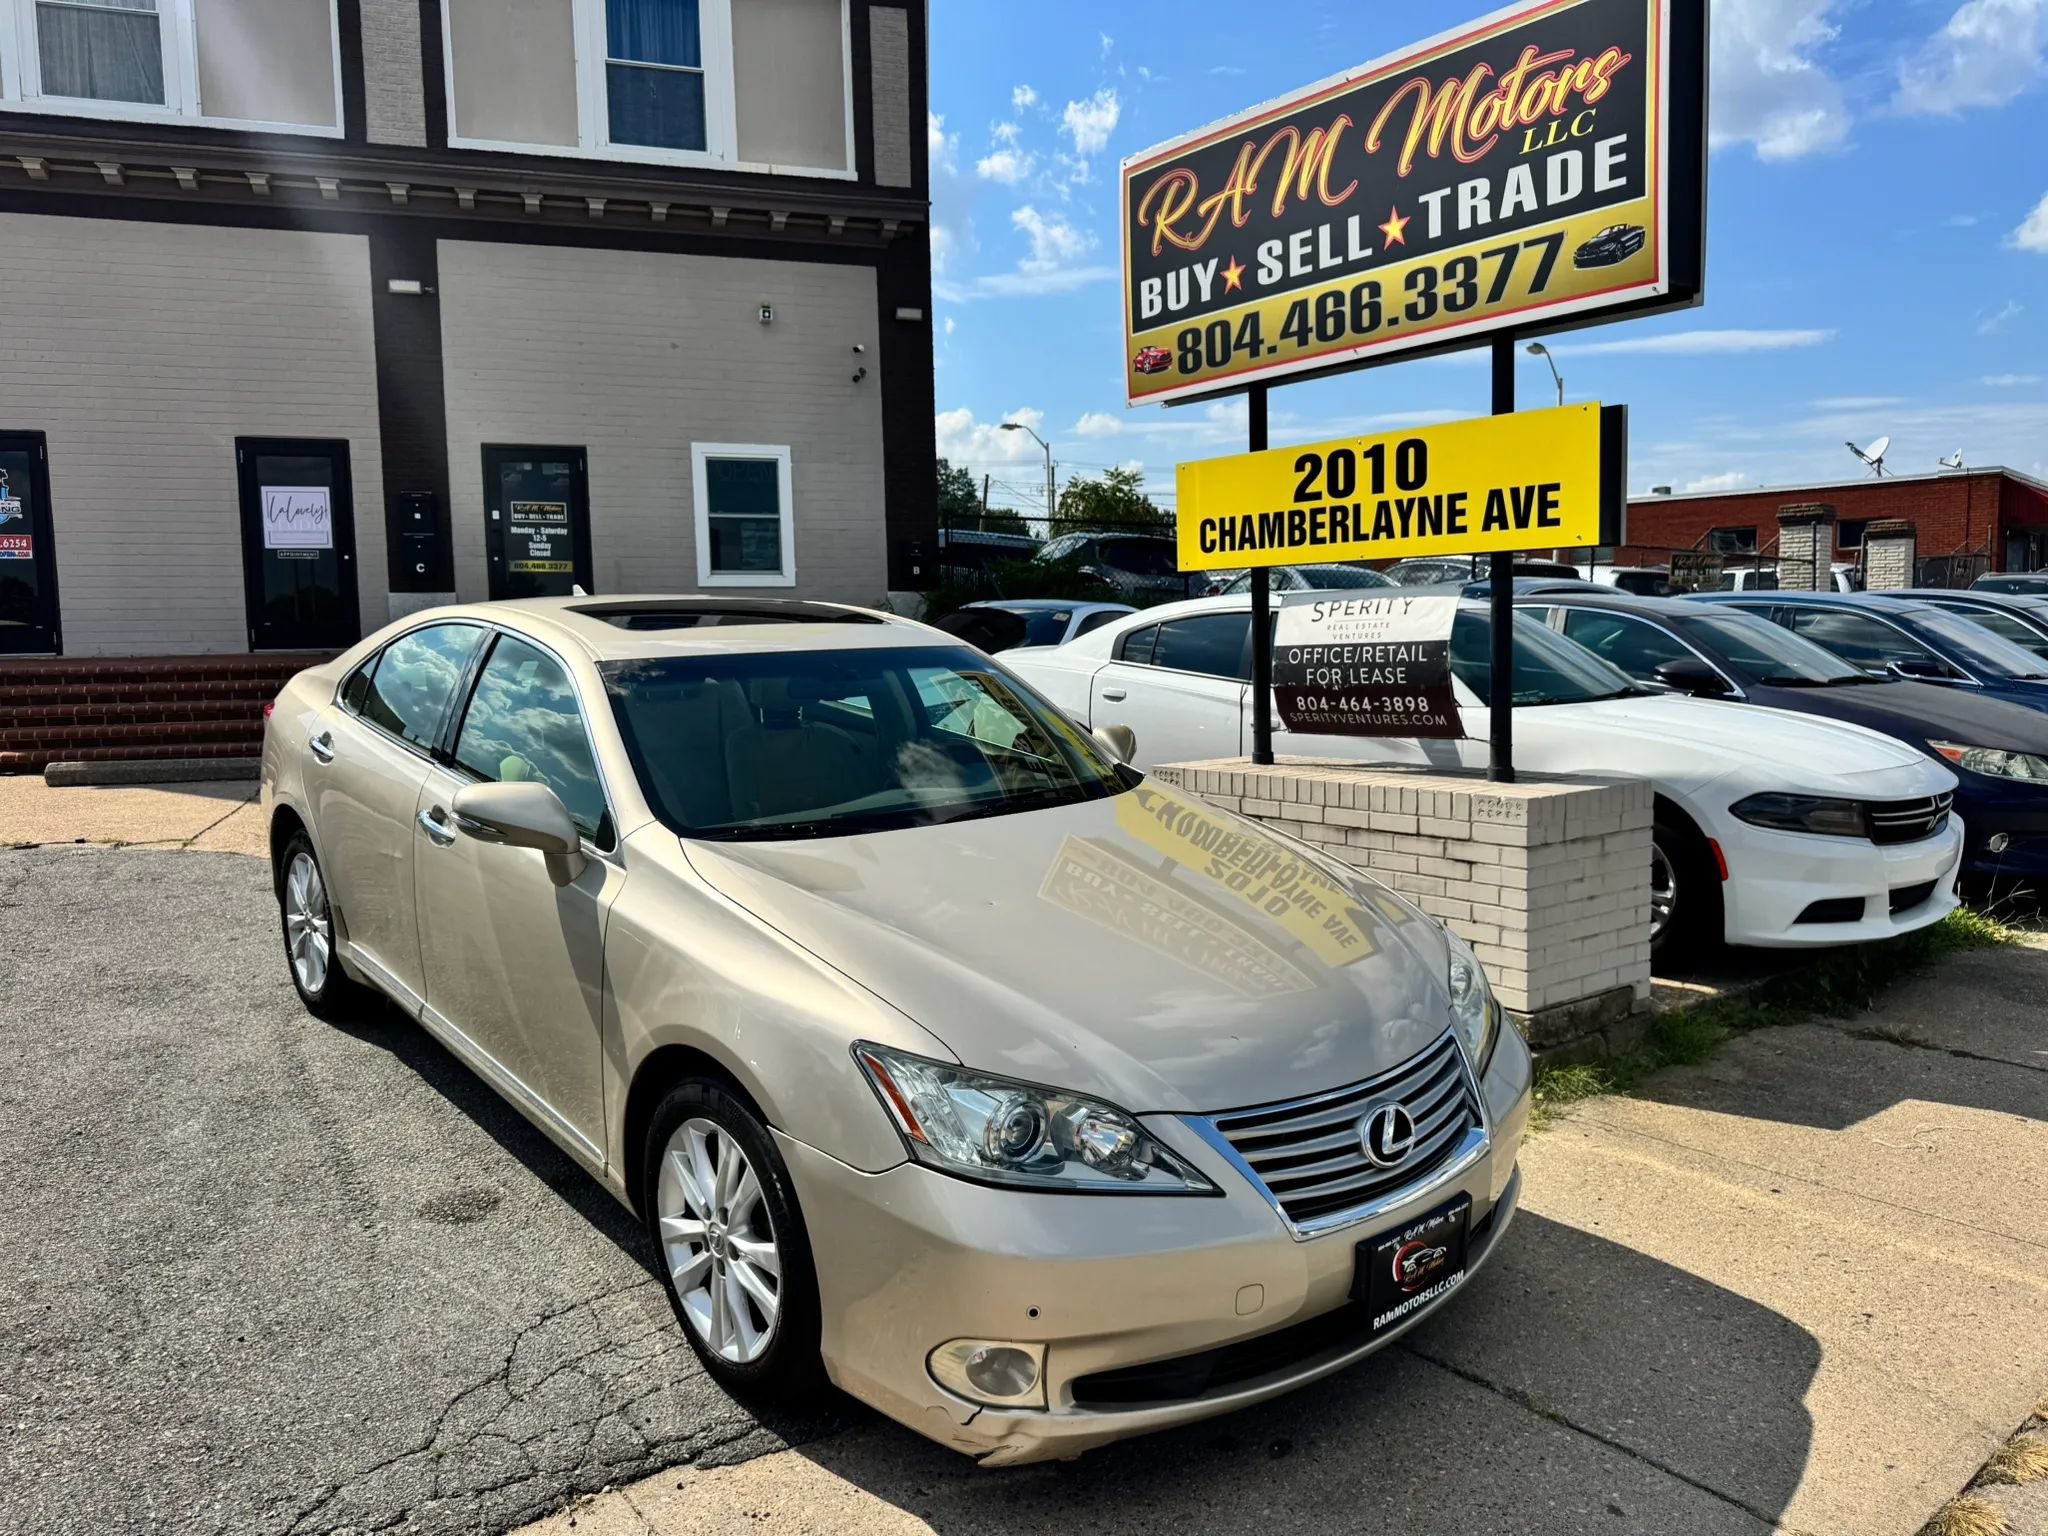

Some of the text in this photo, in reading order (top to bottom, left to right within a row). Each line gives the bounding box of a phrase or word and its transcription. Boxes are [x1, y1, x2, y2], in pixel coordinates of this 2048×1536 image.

[1519, 109, 1597, 155] LLC
[1137, 45, 1631, 256] RAM Motors
[1140, 133, 1628, 319] BUY SELL TRADE
[1177, 231, 1566, 375] 804.466.3377
[1293, 438, 1428, 503] 2010
[1200, 482, 1561, 553] CHAMBERLAYNE AVE
[540, 527, 568, 536] Saturday
[528, 541, 551, 550] Sunday
[530, 549, 551, 557] Closed
[416, 563, 425, 573] C
[913, 566, 920, 575] B
[1311, 599, 1413, 622] SPERITY
[1327, 623, 1349, 631] REAL
[1333, 632, 1382, 640] VENTURES
[1288, 645, 1428, 665] OFFICE/RETAIL
[1306, 667, 1407, 685] FOR LEASE
[1296, 696, 1430, 712] 804-464-3898
[1290, 712, 1447, 726] SPERITYVENTURES.COM
